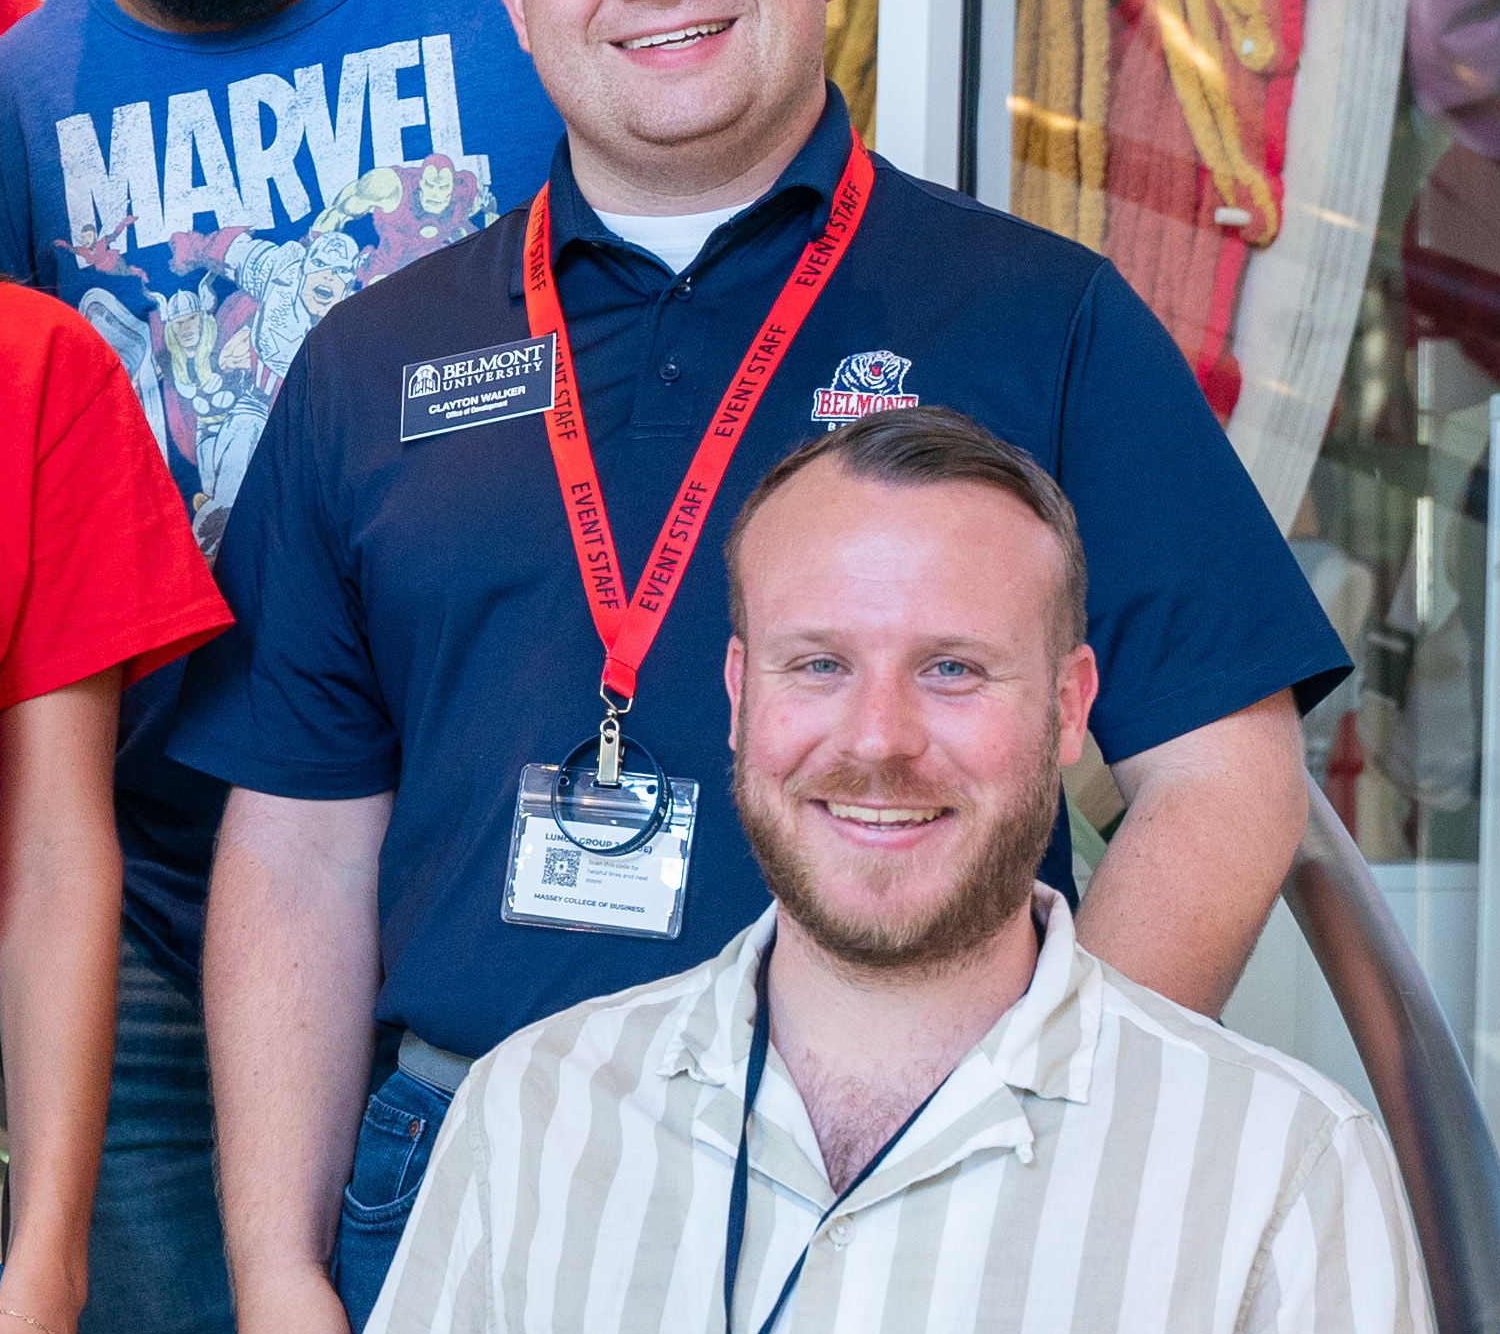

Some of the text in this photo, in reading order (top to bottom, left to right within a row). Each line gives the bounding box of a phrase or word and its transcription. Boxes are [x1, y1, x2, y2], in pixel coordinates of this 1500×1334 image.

[56, 33, 491, 269] MARVEL
[796, 182, 860, 288] EVENT STAFF
[530, 244, 546, 291] STAFF
[442, 344, 545, 380] BELMONT
[442, 360, 544, 391] UNIVERSITY
[714, 324, 787, 438] EVENT STAFF
[428, 385, 526, 414] CLAYTON WALKER
[445, 400, 508, 419] Office of Development
[554, 389, 578, 440] STAFF
[571, 481, 619, 610] EVENT STAFF
[640, 480, 708, 612] EVENT STAFF
[579, 837, 613, 848] GROUP
[534, 893, 563, 903] MASSEY
[563, 896, 596, 908] COLLEGE
[610, 903, 646, 914] BUSINESS
